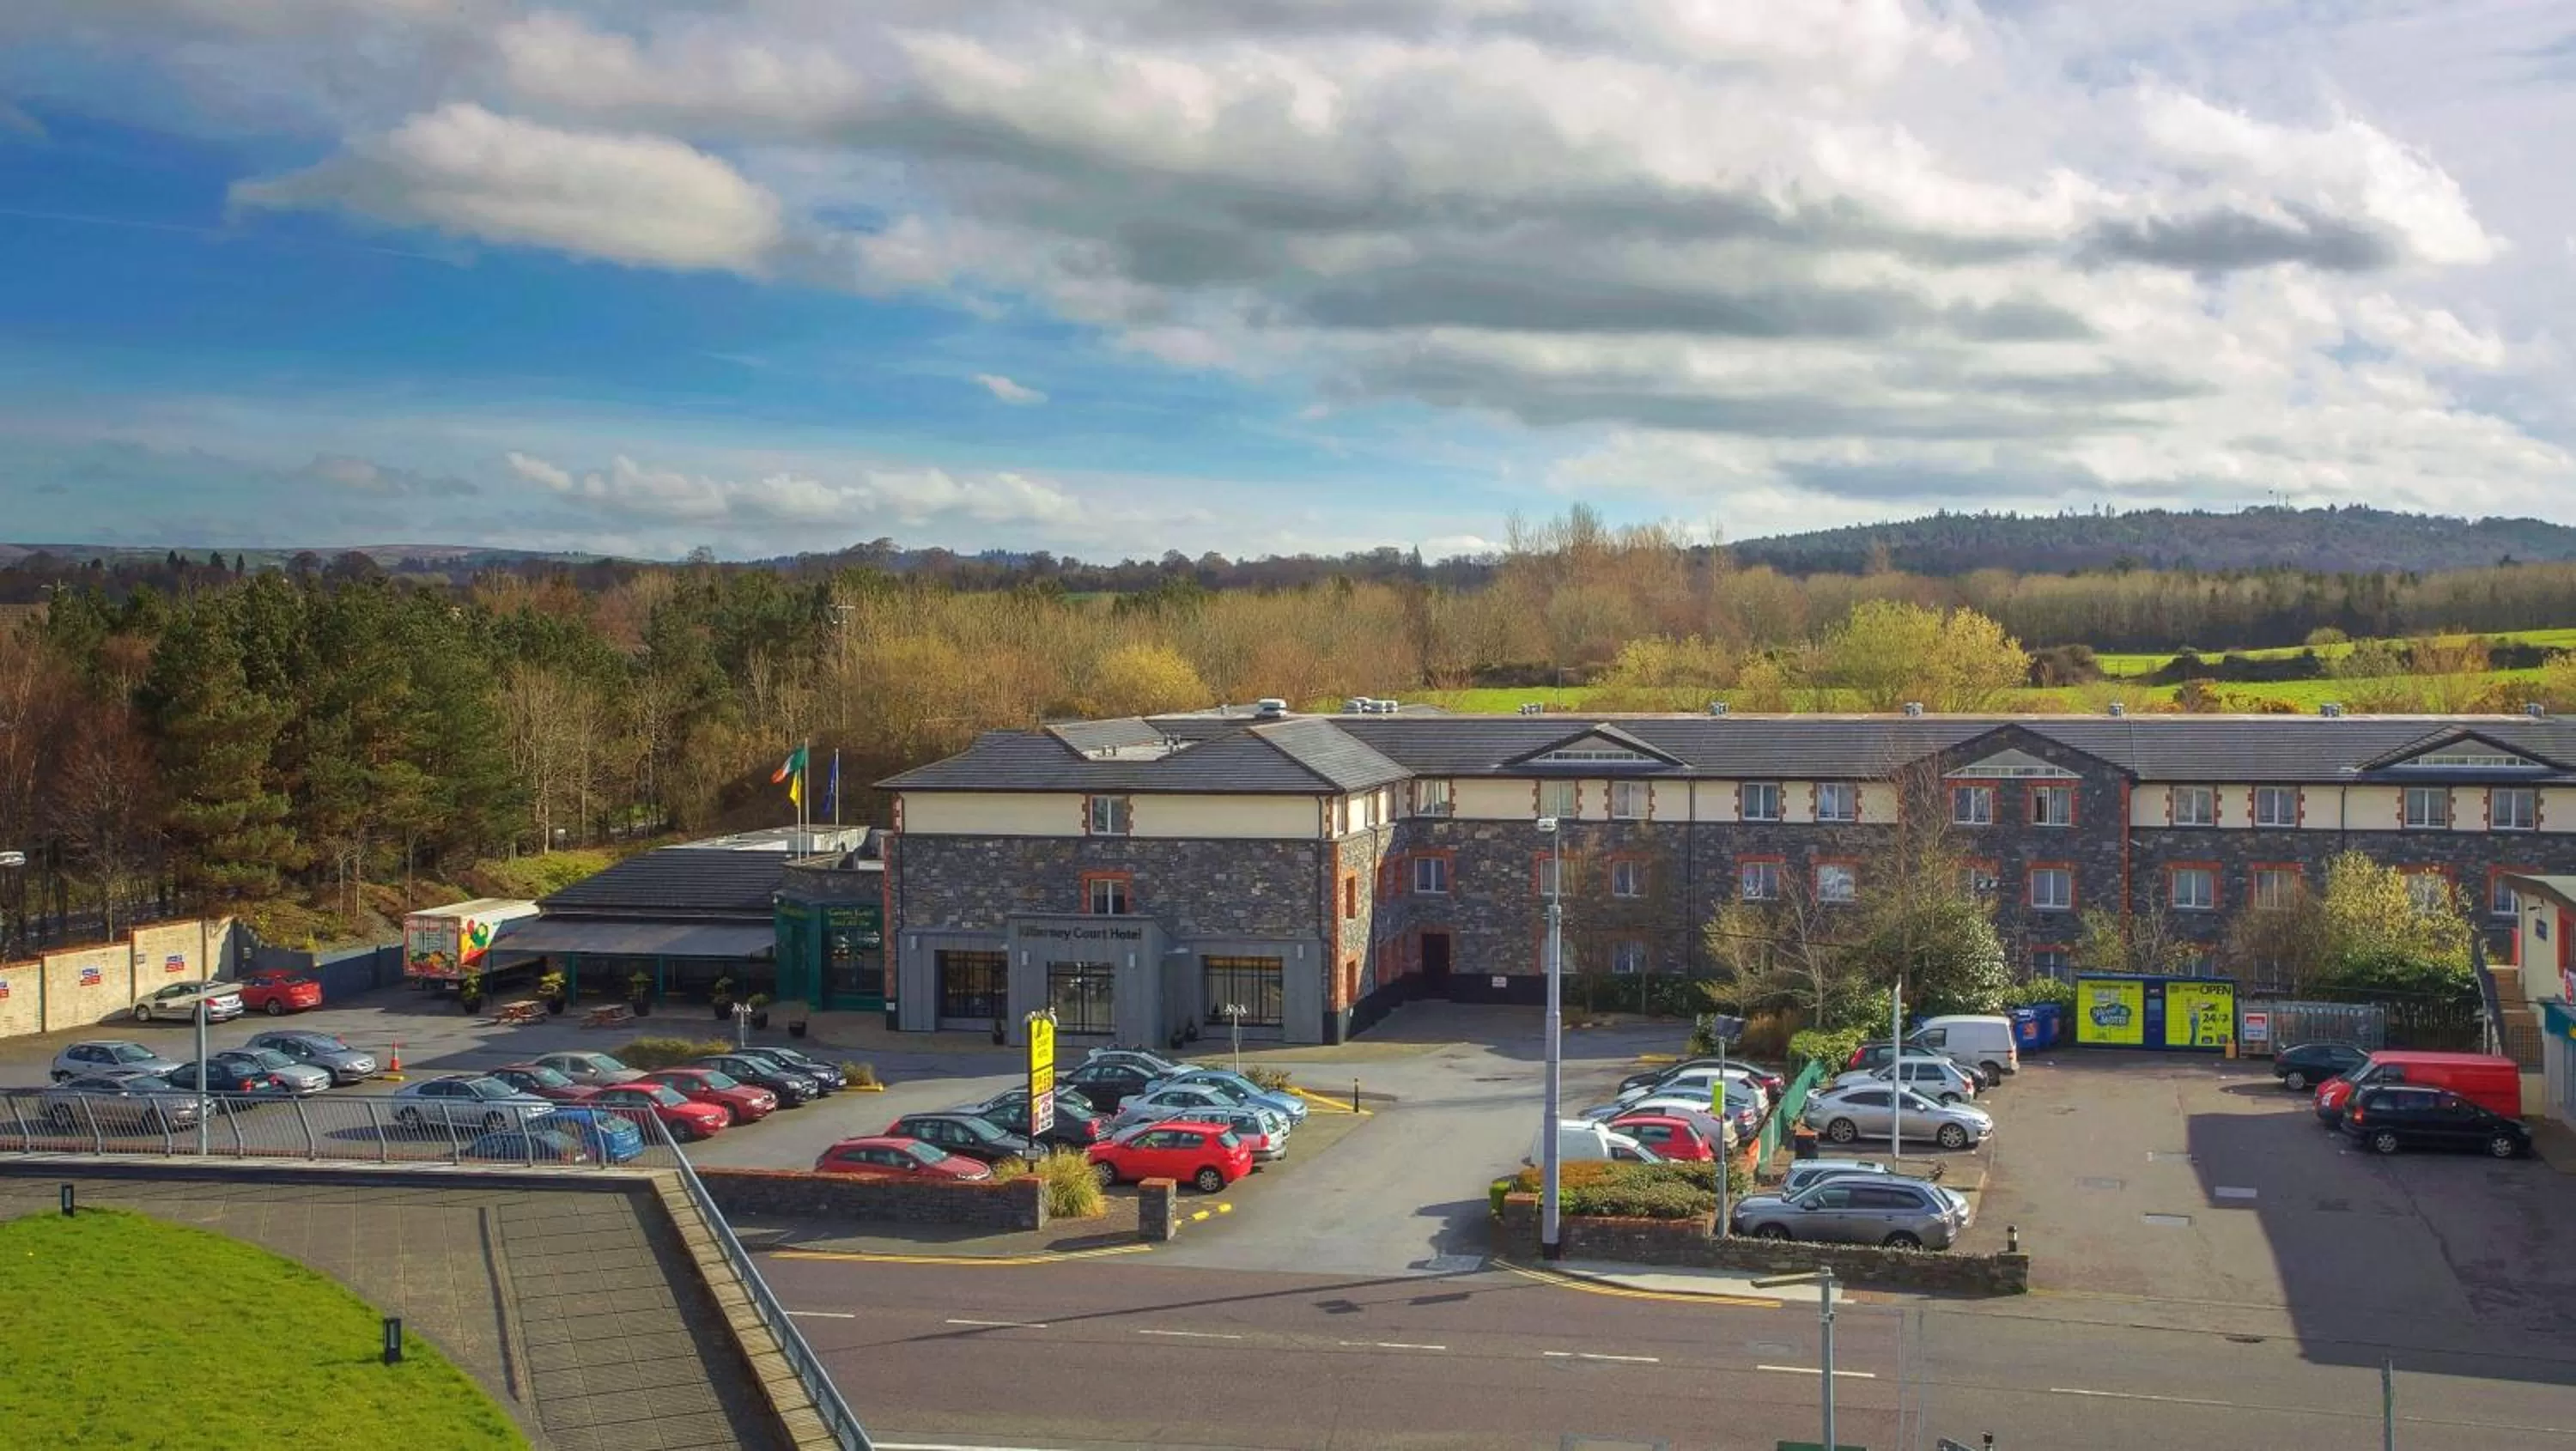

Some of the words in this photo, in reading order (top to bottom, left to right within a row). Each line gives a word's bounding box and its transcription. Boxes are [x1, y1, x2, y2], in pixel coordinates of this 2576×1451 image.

[1073, 926, 1106, 939] Court
[1109, 926, 1141, 940] Hotel
[2200, 985, 2231, 995] OPEN
